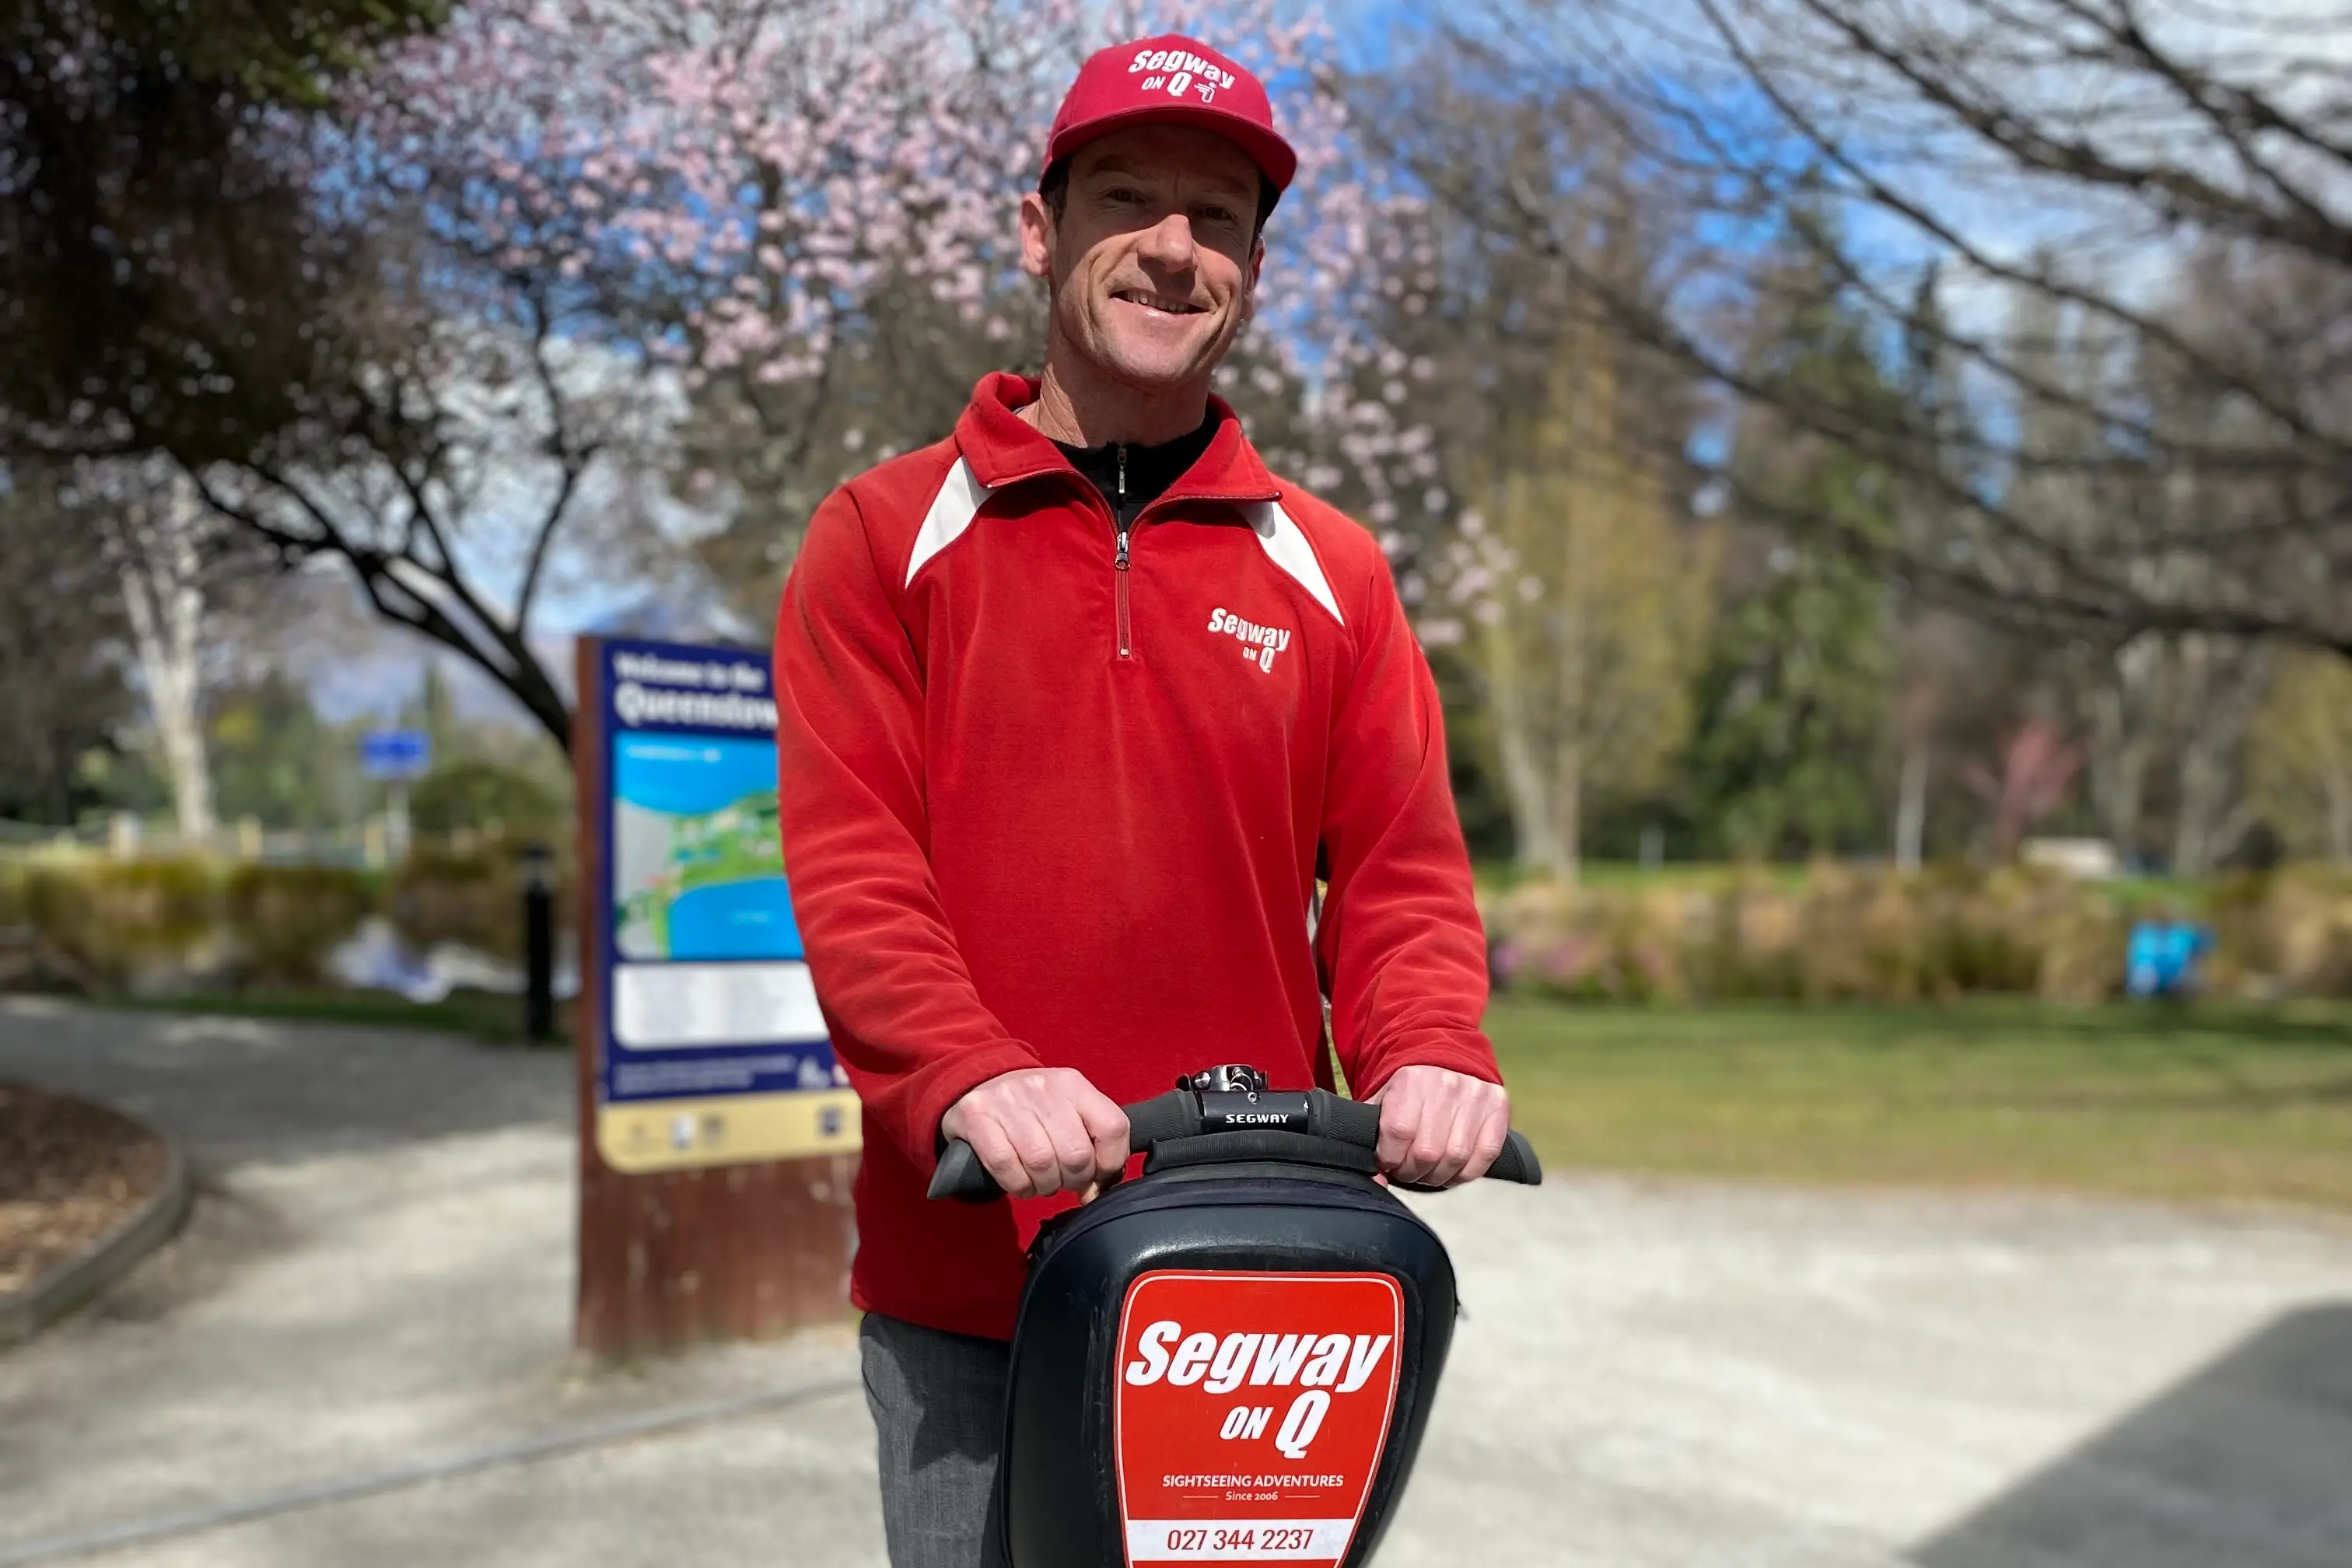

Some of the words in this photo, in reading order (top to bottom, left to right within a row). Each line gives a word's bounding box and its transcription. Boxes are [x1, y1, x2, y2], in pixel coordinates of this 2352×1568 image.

[1128, 50, 1235, 89] Segway
[1141, 76, 1166, 90] ON
[1167, 72, 1192, 96] Q
[1207, 607, 1291, 652] Segway
[612, 651, 703, 686] Welcome
[1242, 646, 1258, 661] ON
[1258, 646, 1275, 674] Q
[1225, 1114, 1289, 1124] SEGWAY
[1125, 1320, 1393, 1395] Segway
[1219, 1405, 1274, 1440] ON
[1274, 1389, 1332, 1460] Q
[1162, 1475, 1251, 1487] SIGHTSEEING
[1253, 1475, 1344, 1487] ADVENTURES
[1225, 1490, 1253, 1501] Since
[1254, 1490, 1279, 1501] 2006
[1167, 1529, 1208, 1551] 027
[1213, 1529, 1255, 1551] 344
[1260, 1529, 1314, 1551] 2237
